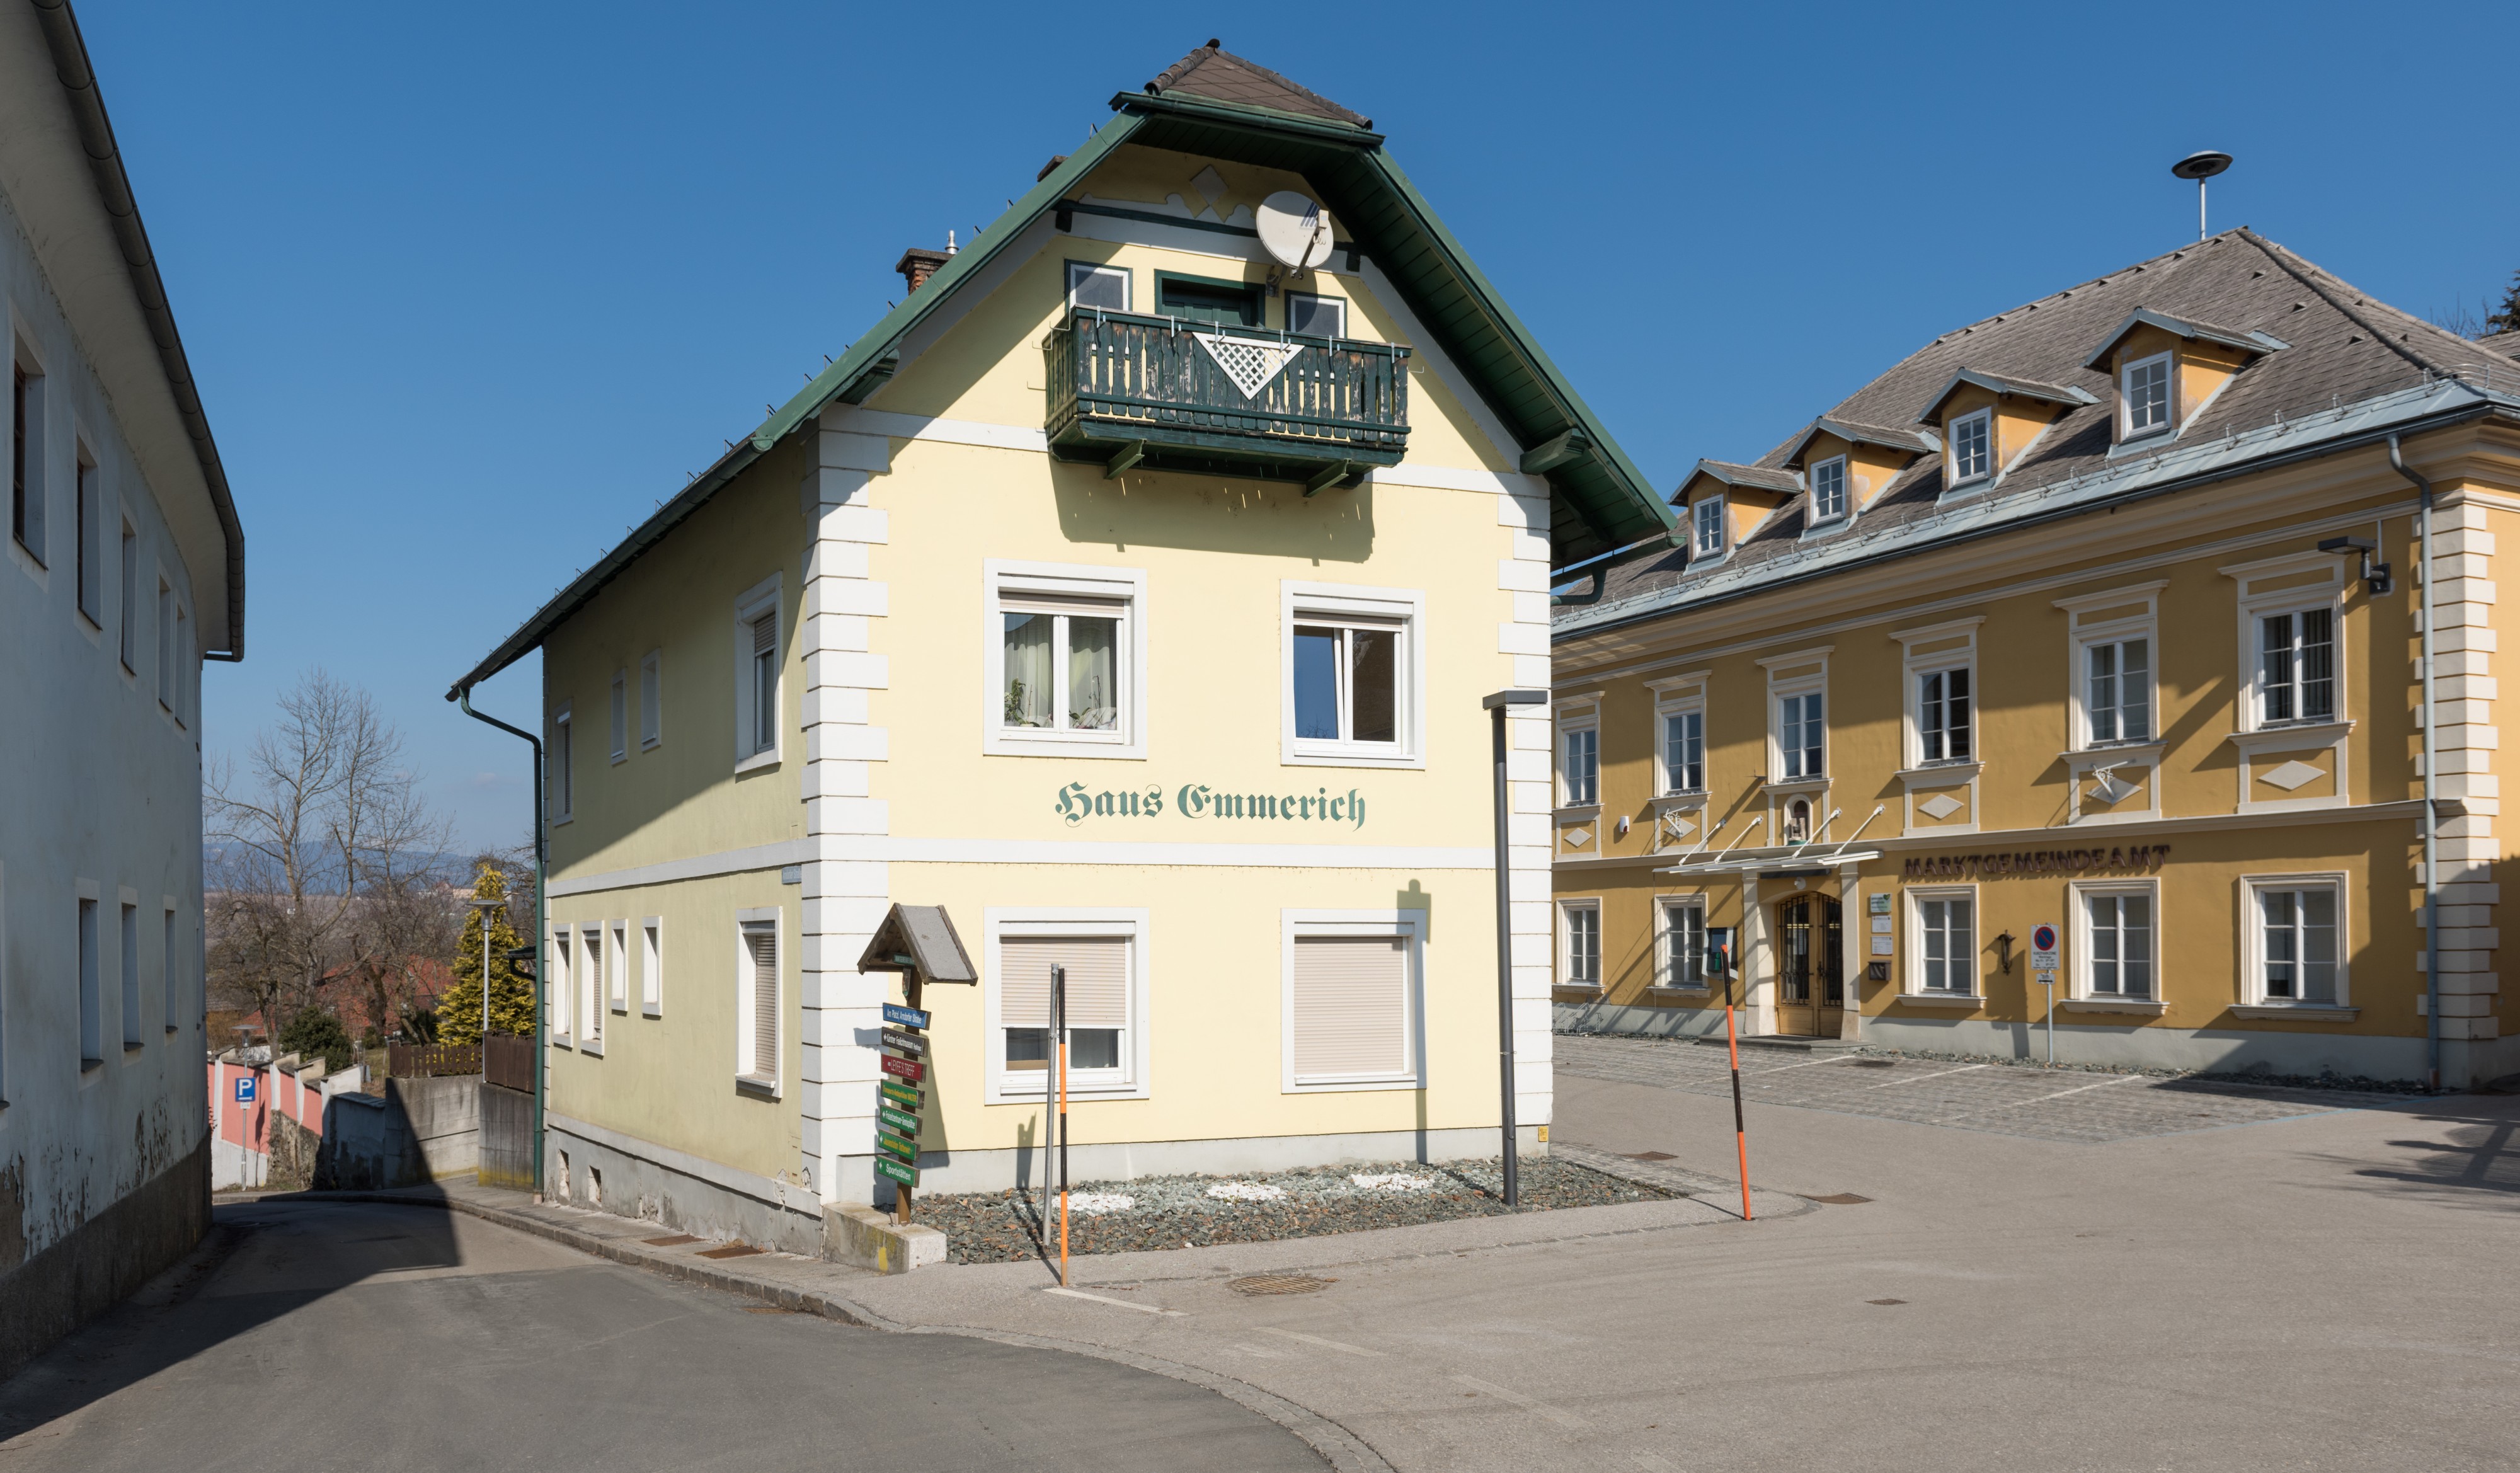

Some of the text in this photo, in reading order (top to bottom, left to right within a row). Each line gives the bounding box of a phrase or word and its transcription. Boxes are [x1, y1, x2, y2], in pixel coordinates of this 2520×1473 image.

[1055, 781, 1366, 832] Haus Emmerich
[1904, 844, 2171, 877] MARKTGEMEINDEAMT
[886, 1009, 891, 1017] Am
[904, 1063, 915, 1077] TREFF
[239, 1079, 253, 1096] P
[886, 1163, 911, 1181] Sportstätten
